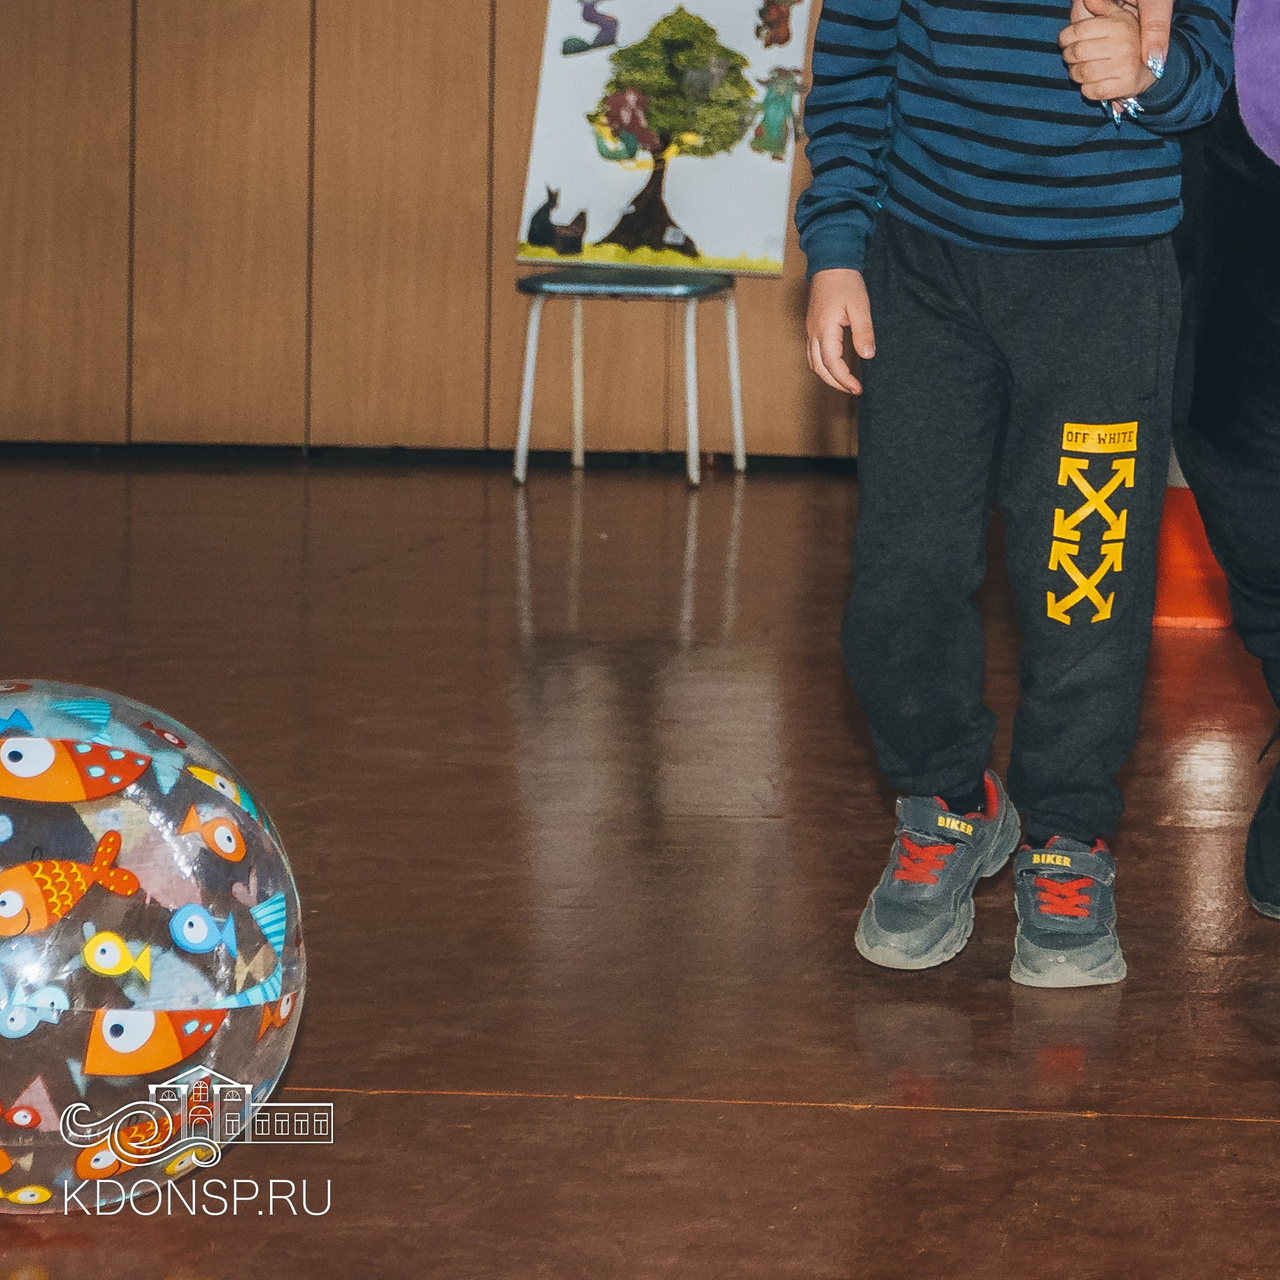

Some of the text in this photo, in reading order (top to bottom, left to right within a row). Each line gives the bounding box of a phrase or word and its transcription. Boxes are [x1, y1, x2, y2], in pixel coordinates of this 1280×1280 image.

[1066, 430, 1133, 444] OFF WHITE
[937, 815, 973, 835] BIKER
[1032, 853, 1072, 868] BIKER
